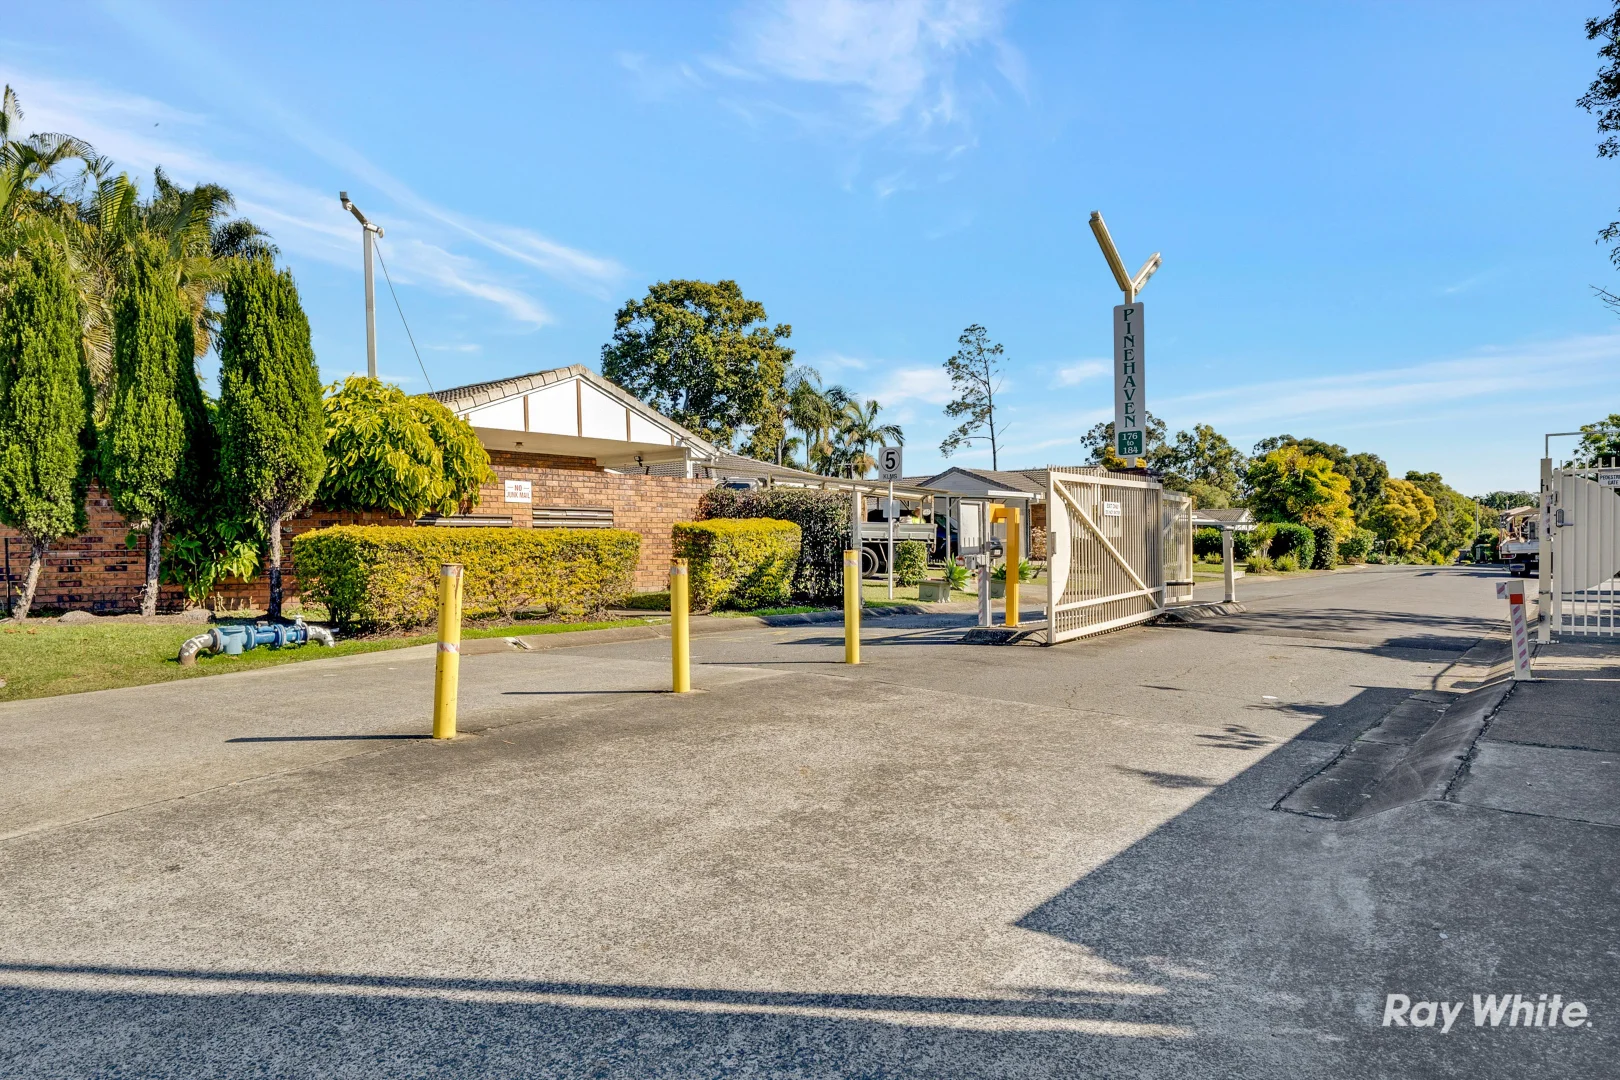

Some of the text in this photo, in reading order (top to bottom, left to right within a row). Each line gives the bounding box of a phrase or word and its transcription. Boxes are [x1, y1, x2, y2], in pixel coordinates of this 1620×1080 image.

[1123, 308, 1137, 428] PINEHAVEN
[1122, 432, 1138, 441] 176
[1123, 446, 1139, 455] 184
[885, 451, 896, 470] 5
[514, 484, 523, 492] NO
[519, 491, 531, 499] MAIL
